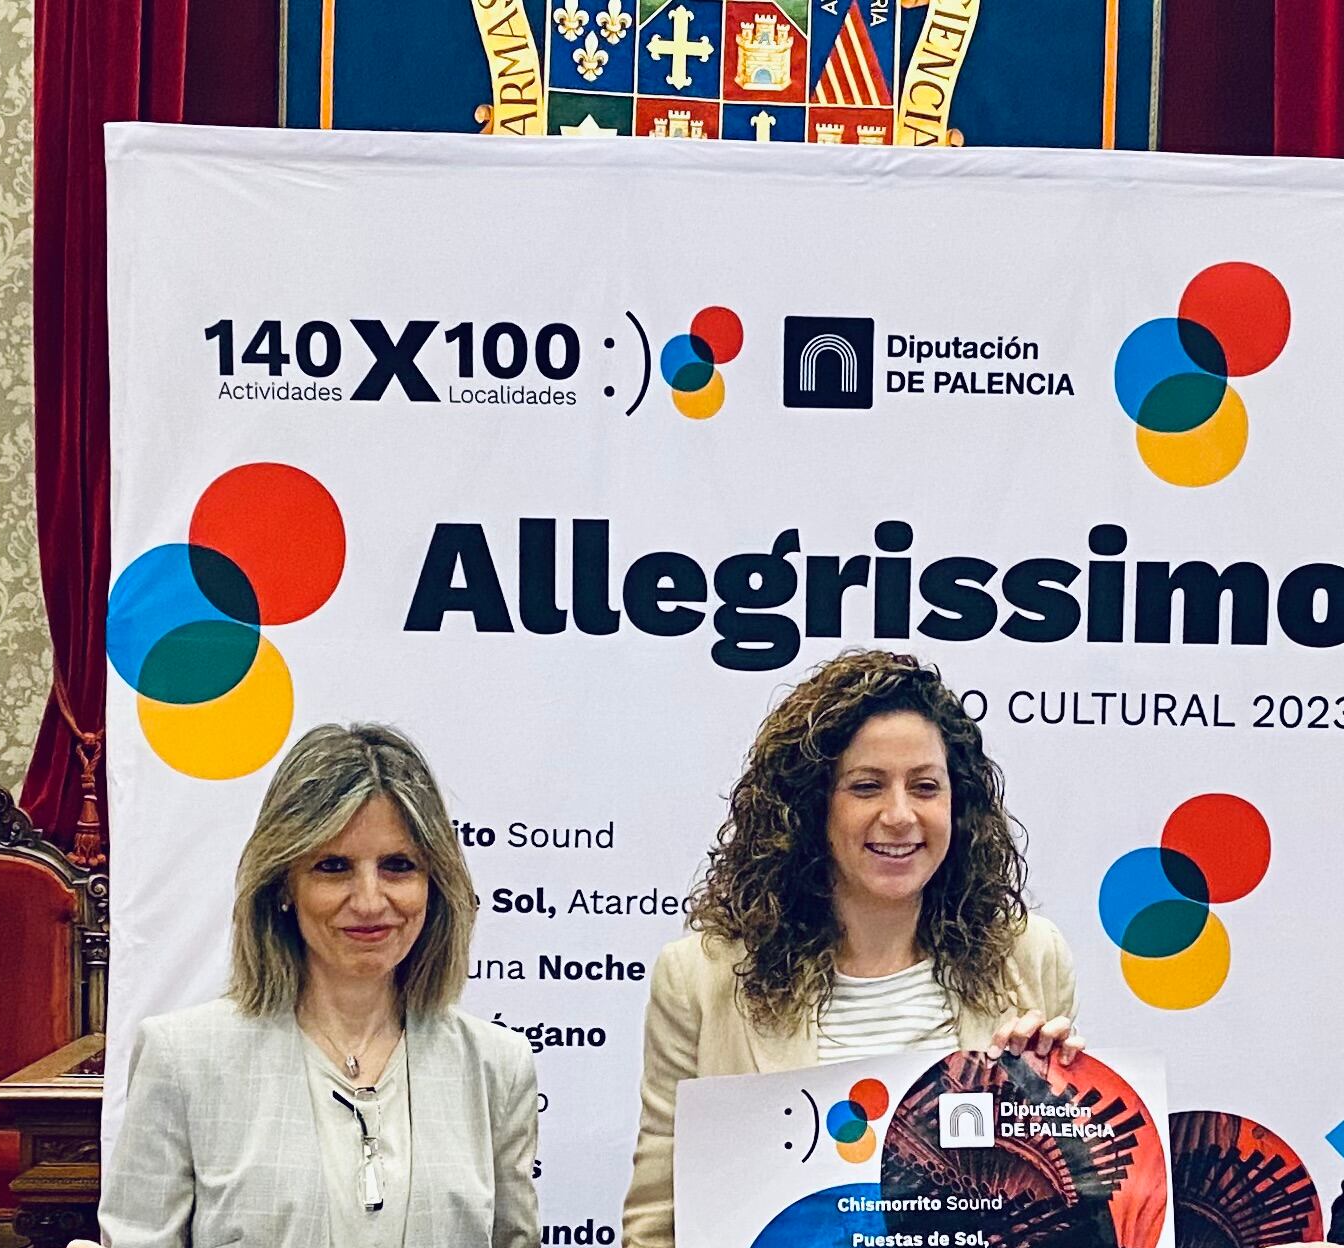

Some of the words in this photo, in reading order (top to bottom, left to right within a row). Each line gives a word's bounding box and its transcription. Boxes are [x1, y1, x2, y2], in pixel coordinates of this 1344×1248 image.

[903, 0, 972, 147] IENCIA
[888, 335, 1038, 363] Diputación
[219, 382, 342, 401] Actividades
[450, 385, 576, 405] Localidades
[887, 371, 924, 393] DE
[934, 372, 1074, 395] PALENCIA
[1009, 691, 1235, 727] CULTURAL
[508, 821, 613, 848] Sound
[492, 887, 556, 918] Sol,
[567, 888, 690, 915] Atardec
[540, 954, 645, 981] Noche
[1001, 1101, 1092, 1120] Diputación
[1001, 1122, 1026, 1137] DE
[1030, 1122, 1115, 1138] PALENCIA
[838, 1197, 942, 1212] Chismorrito
[946, 1195, 1002, 1211] Sound
[541, 1219, 615, 1246] undo
[852, 1233, 922, 1247] Puestas
[927, 1232, 950, 1247] de
[954, 1231, 989, 1248] Sol,
